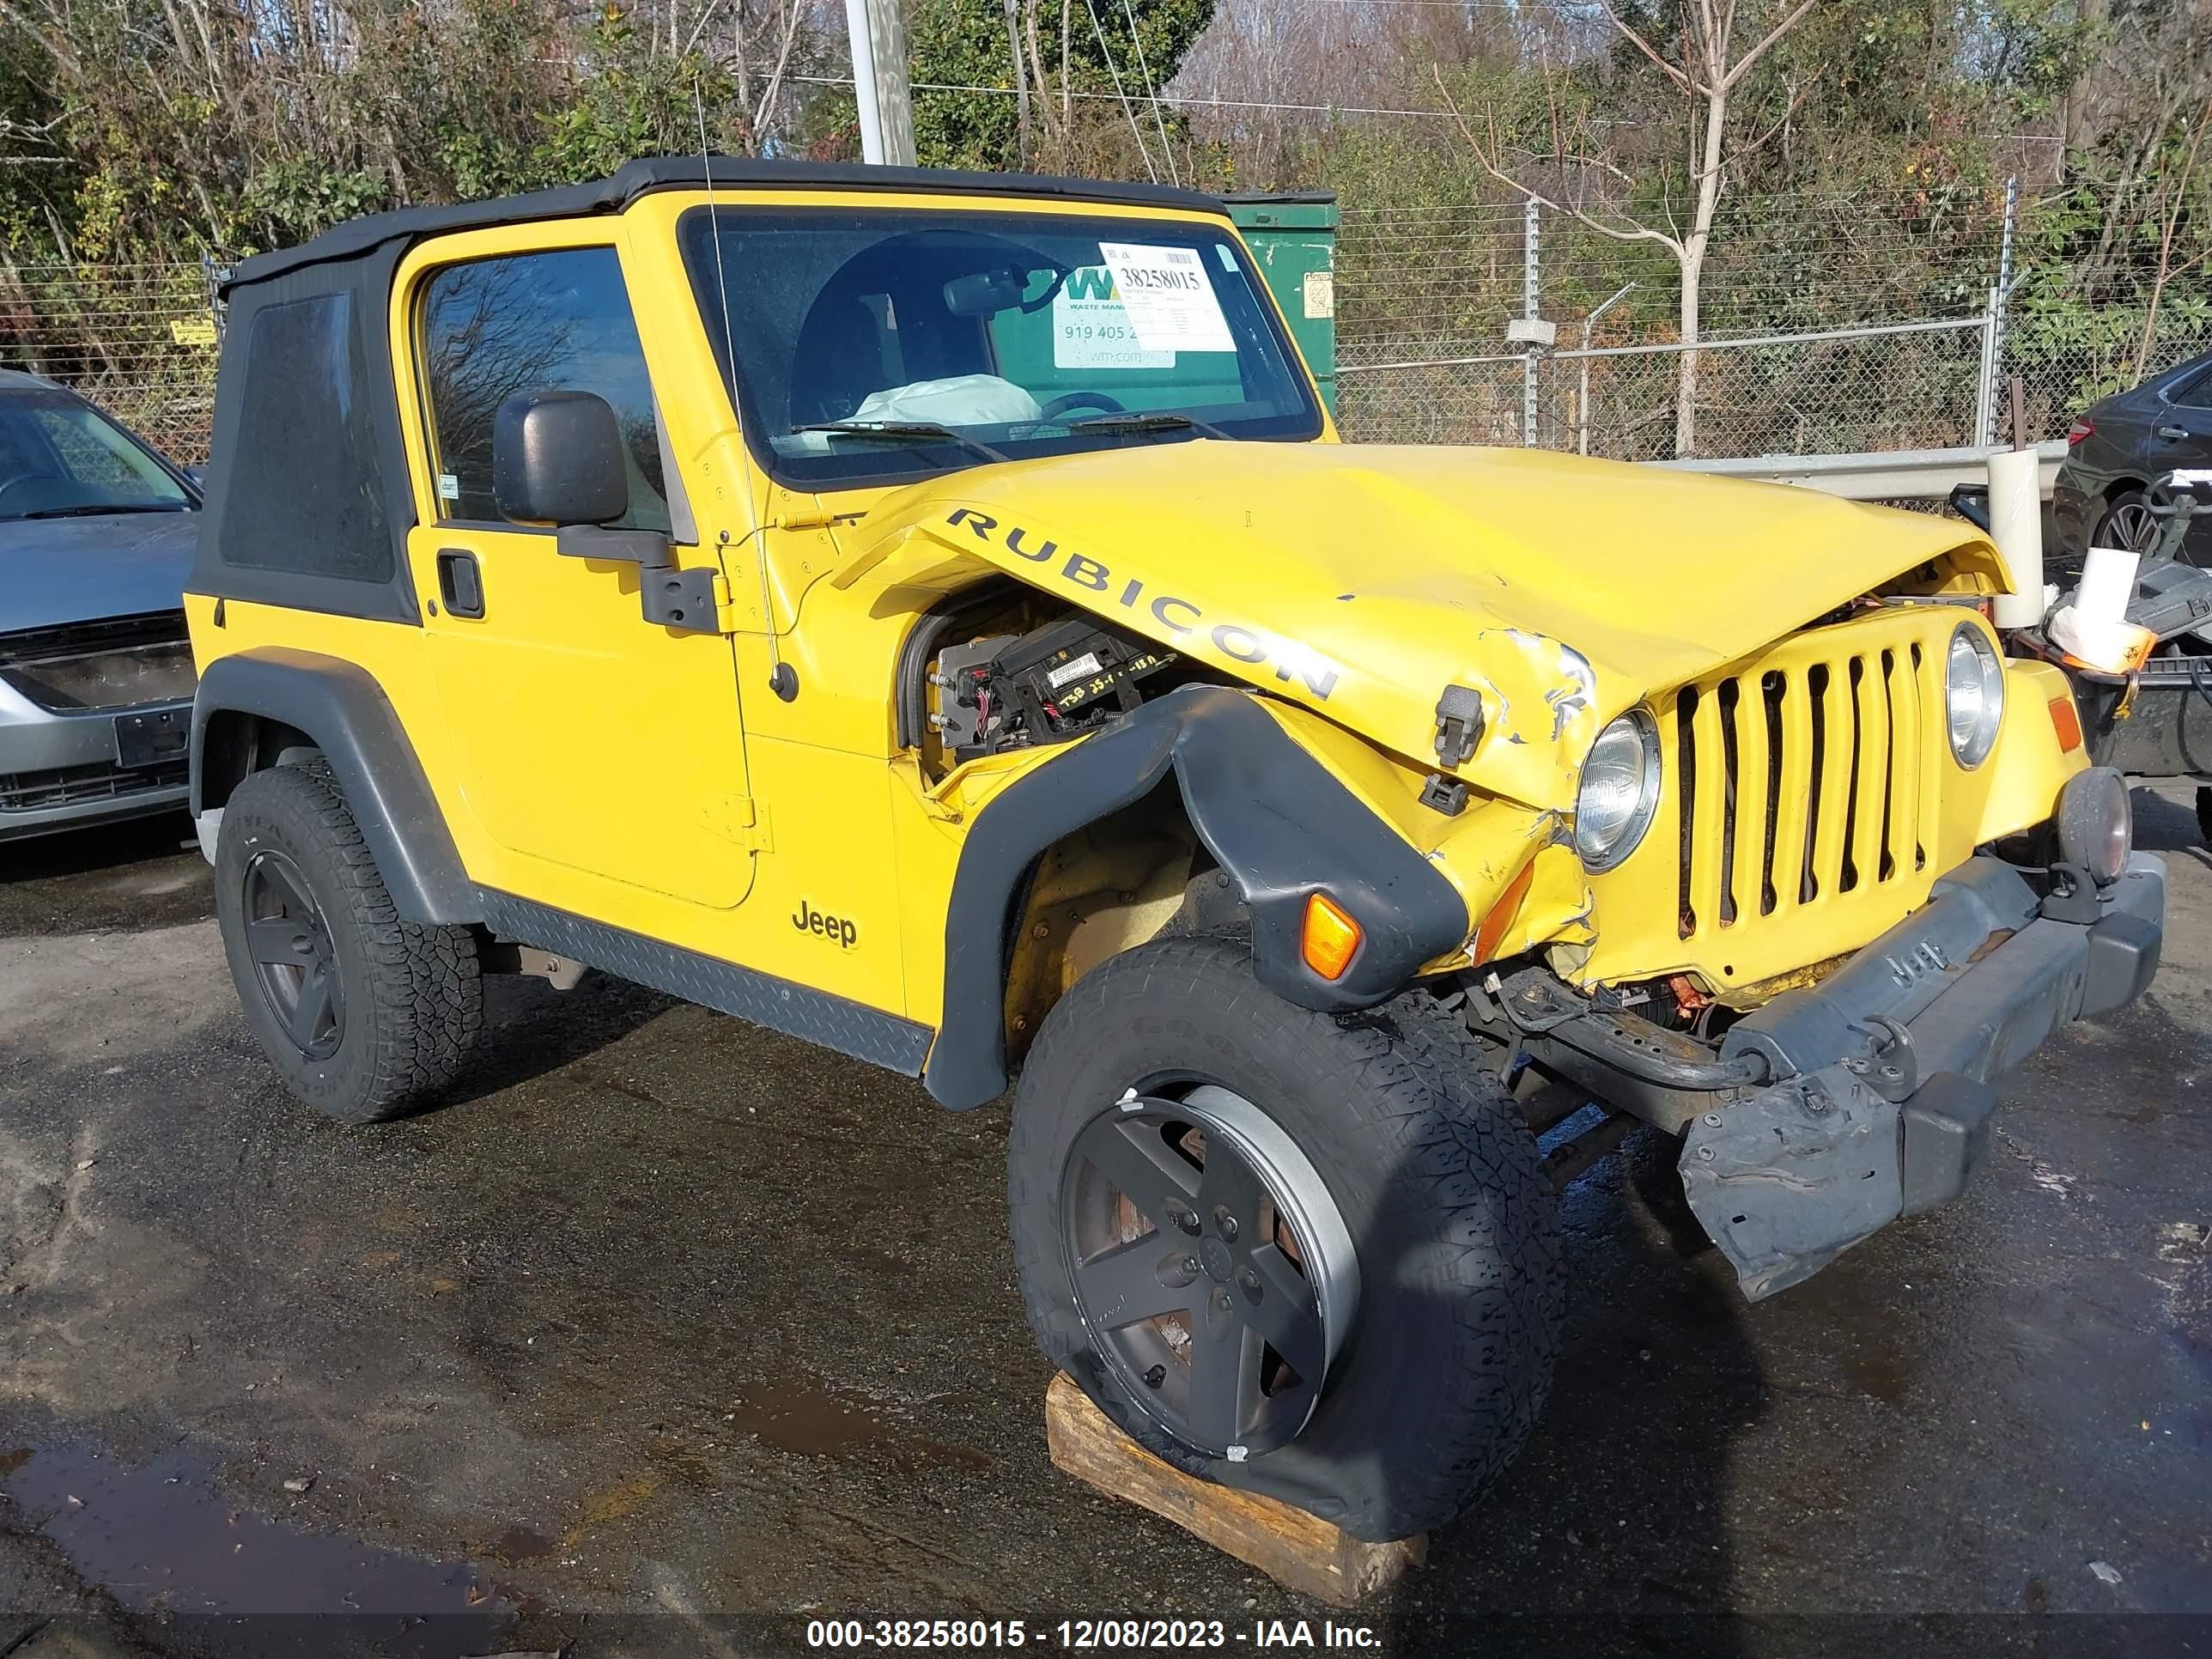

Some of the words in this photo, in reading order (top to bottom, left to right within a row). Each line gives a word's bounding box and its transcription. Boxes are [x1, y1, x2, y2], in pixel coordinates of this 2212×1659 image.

[1066, 269, 1120, 301] W
[1121, 267, 1200, 290] 38258015
[1065, 326, 1092, 339] 919
[1097, 327, 1124, 339] 405
[1091, 350, 1142, 363] wm.com
[945, 507, 1340, 702] RUBICON
[792, 899, 857, 949] Jeep
[1885, 940, 1948, 989] Jeep
